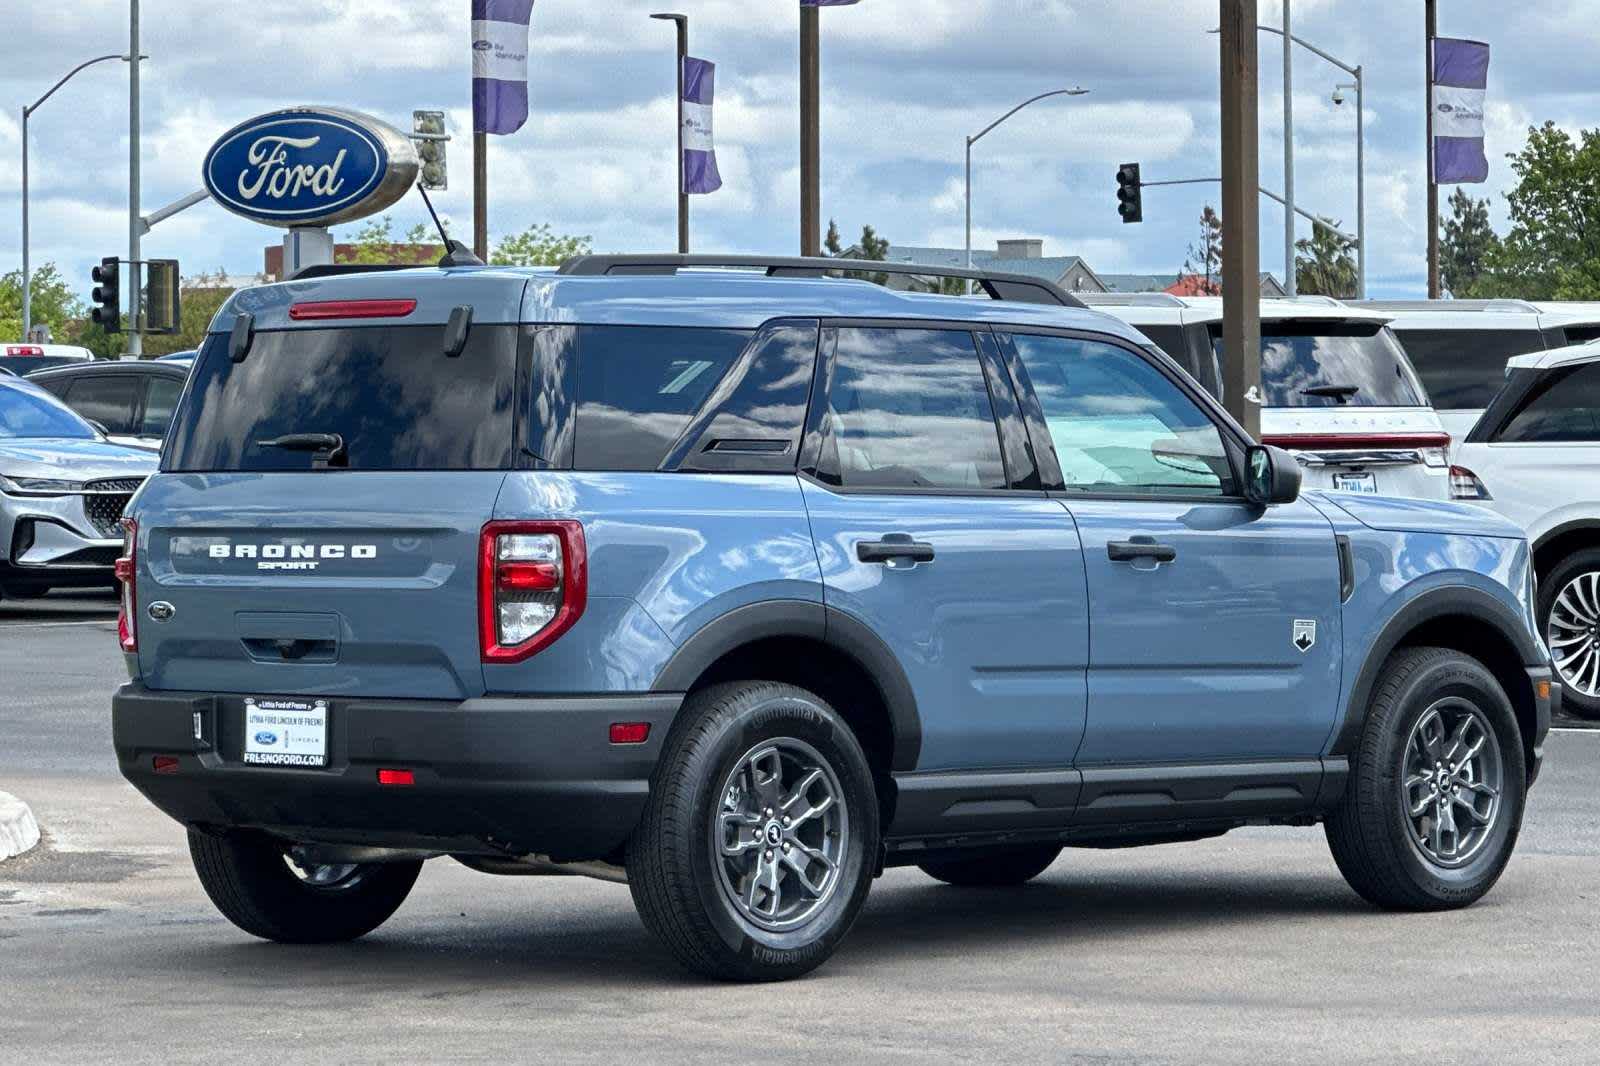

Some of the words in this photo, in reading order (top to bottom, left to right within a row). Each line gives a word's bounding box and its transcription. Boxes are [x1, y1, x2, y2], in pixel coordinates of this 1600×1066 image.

[237, 135, 347, 200] Ford
[208, 544, 377, 559] BRONCO
[257, 561, 320, 570] SPORT
[244, 753, 324, 766] FRESNOFORD.COM
